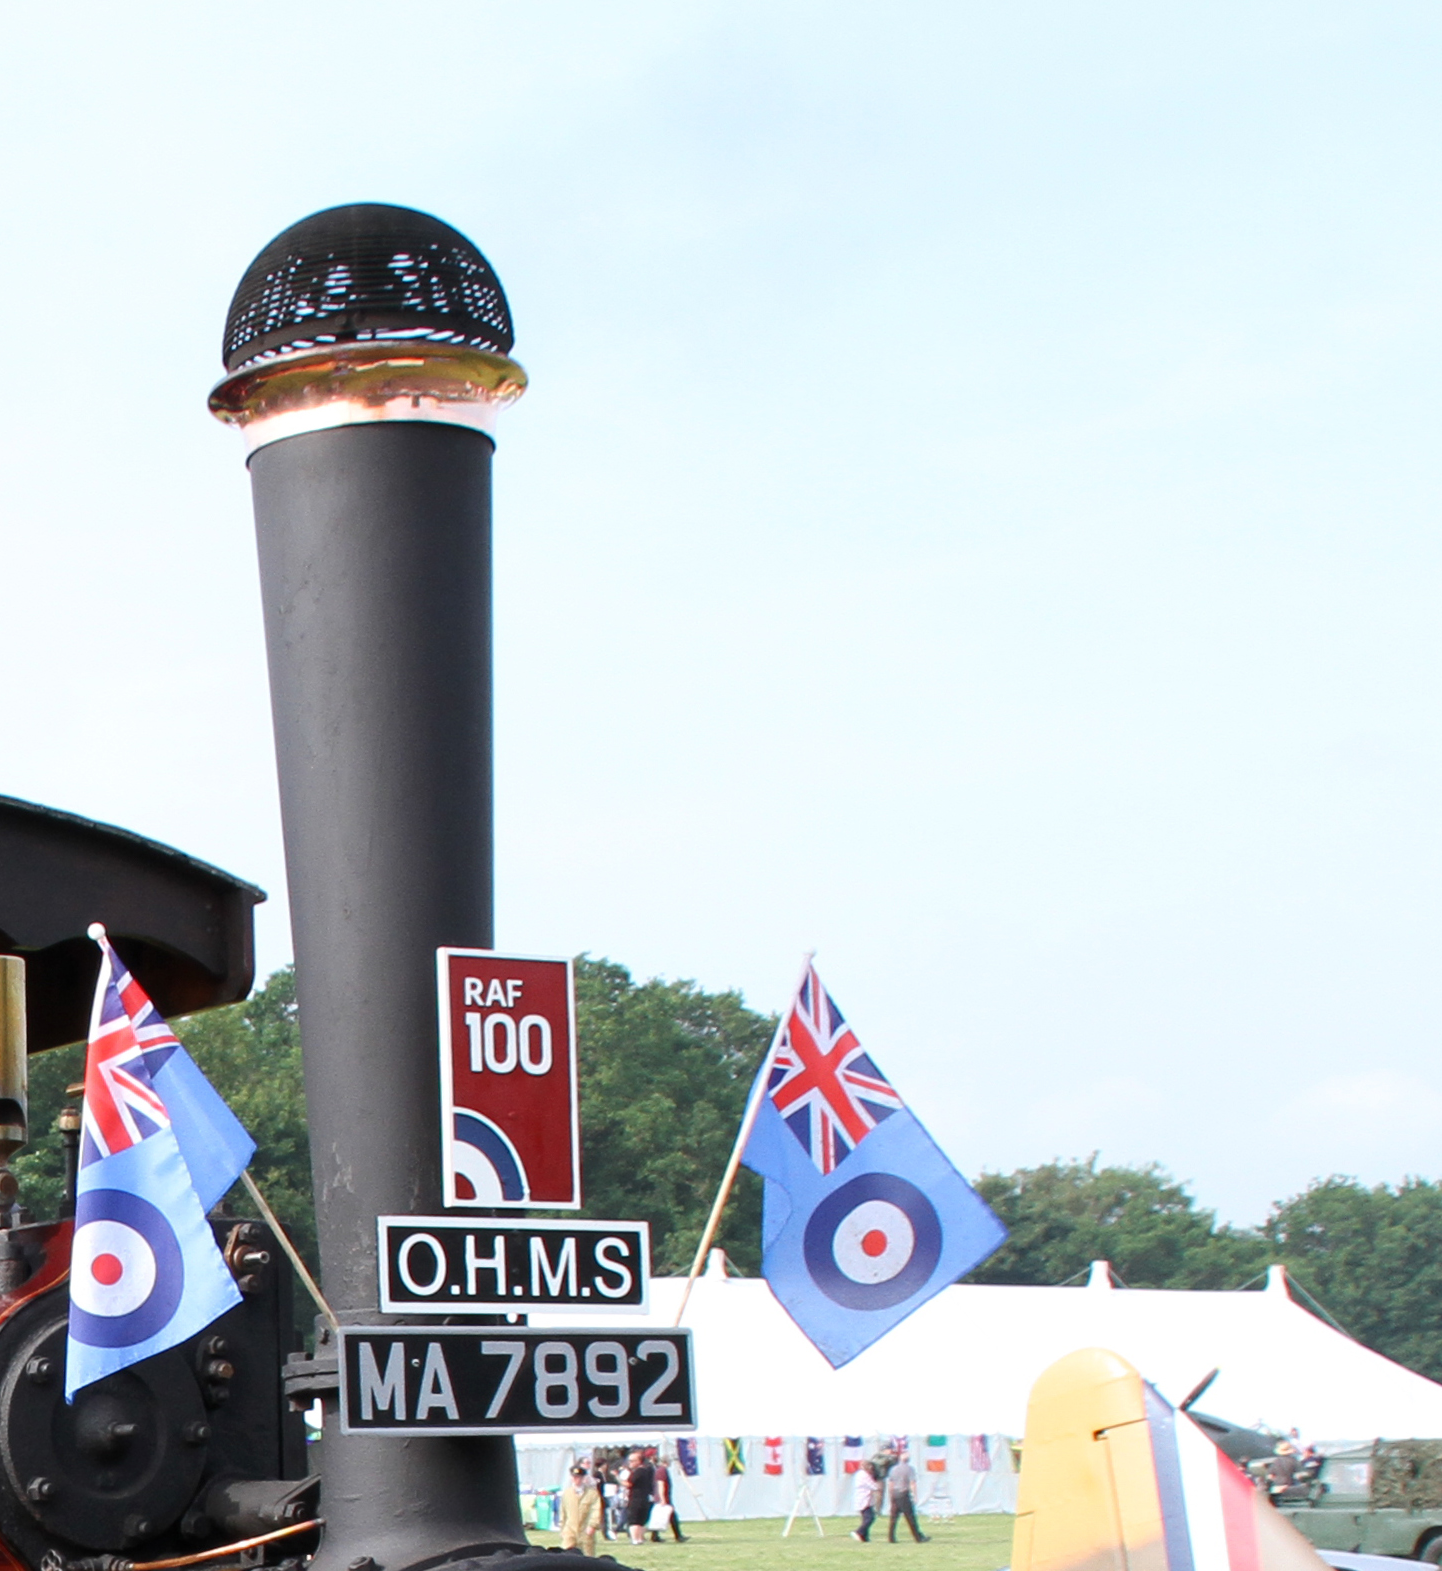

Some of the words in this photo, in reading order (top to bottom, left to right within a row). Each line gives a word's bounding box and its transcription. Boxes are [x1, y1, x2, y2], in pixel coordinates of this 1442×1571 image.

[464, 978, 523, 1007] RAF
[465, 1012, 553, 1076] 100
[398, 1233, 633, 1298] O.H.M.S
[358, 1341, 459, 1421] MA
[481, 1340, 682, 1419] 7892
